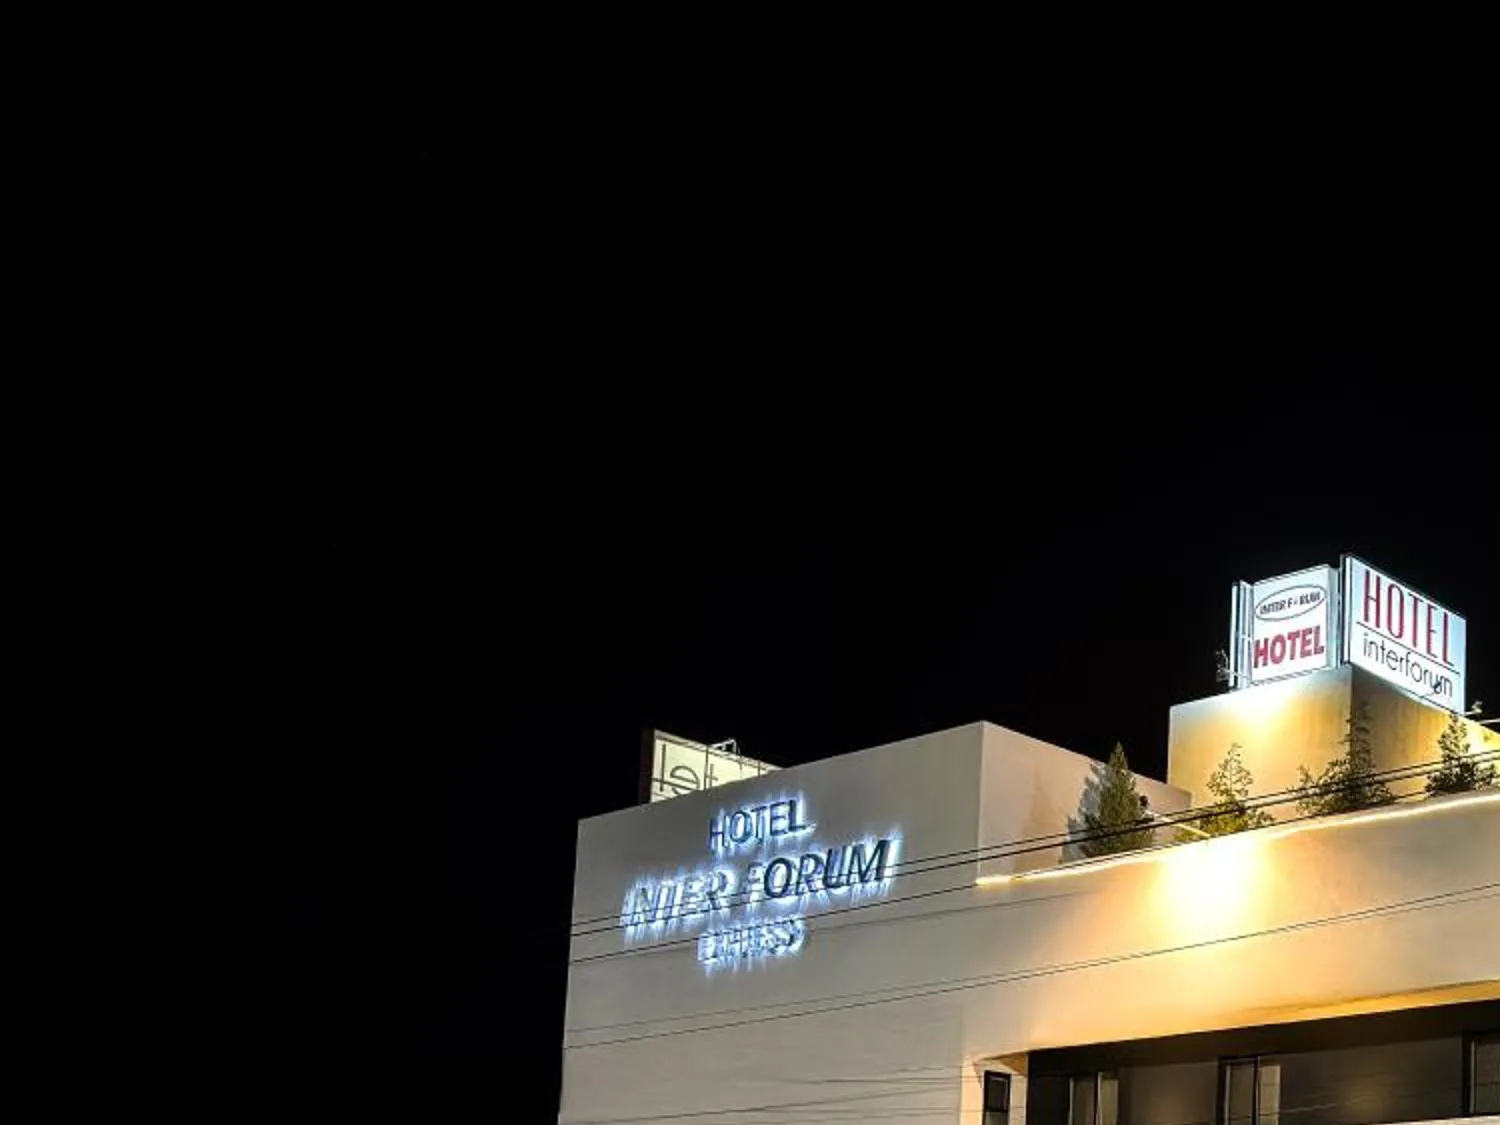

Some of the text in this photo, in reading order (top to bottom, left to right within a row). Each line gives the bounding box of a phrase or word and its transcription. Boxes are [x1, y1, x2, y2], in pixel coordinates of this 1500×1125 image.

[1253, 625, 1325, 669] HOTEL
[1362, 569, 1455, 667] HOTEL
[1362, 633, 1453, 698] interforum
[708, 799, 812, 850] HOTEL
[744, 838, 892, 906] FORUM
